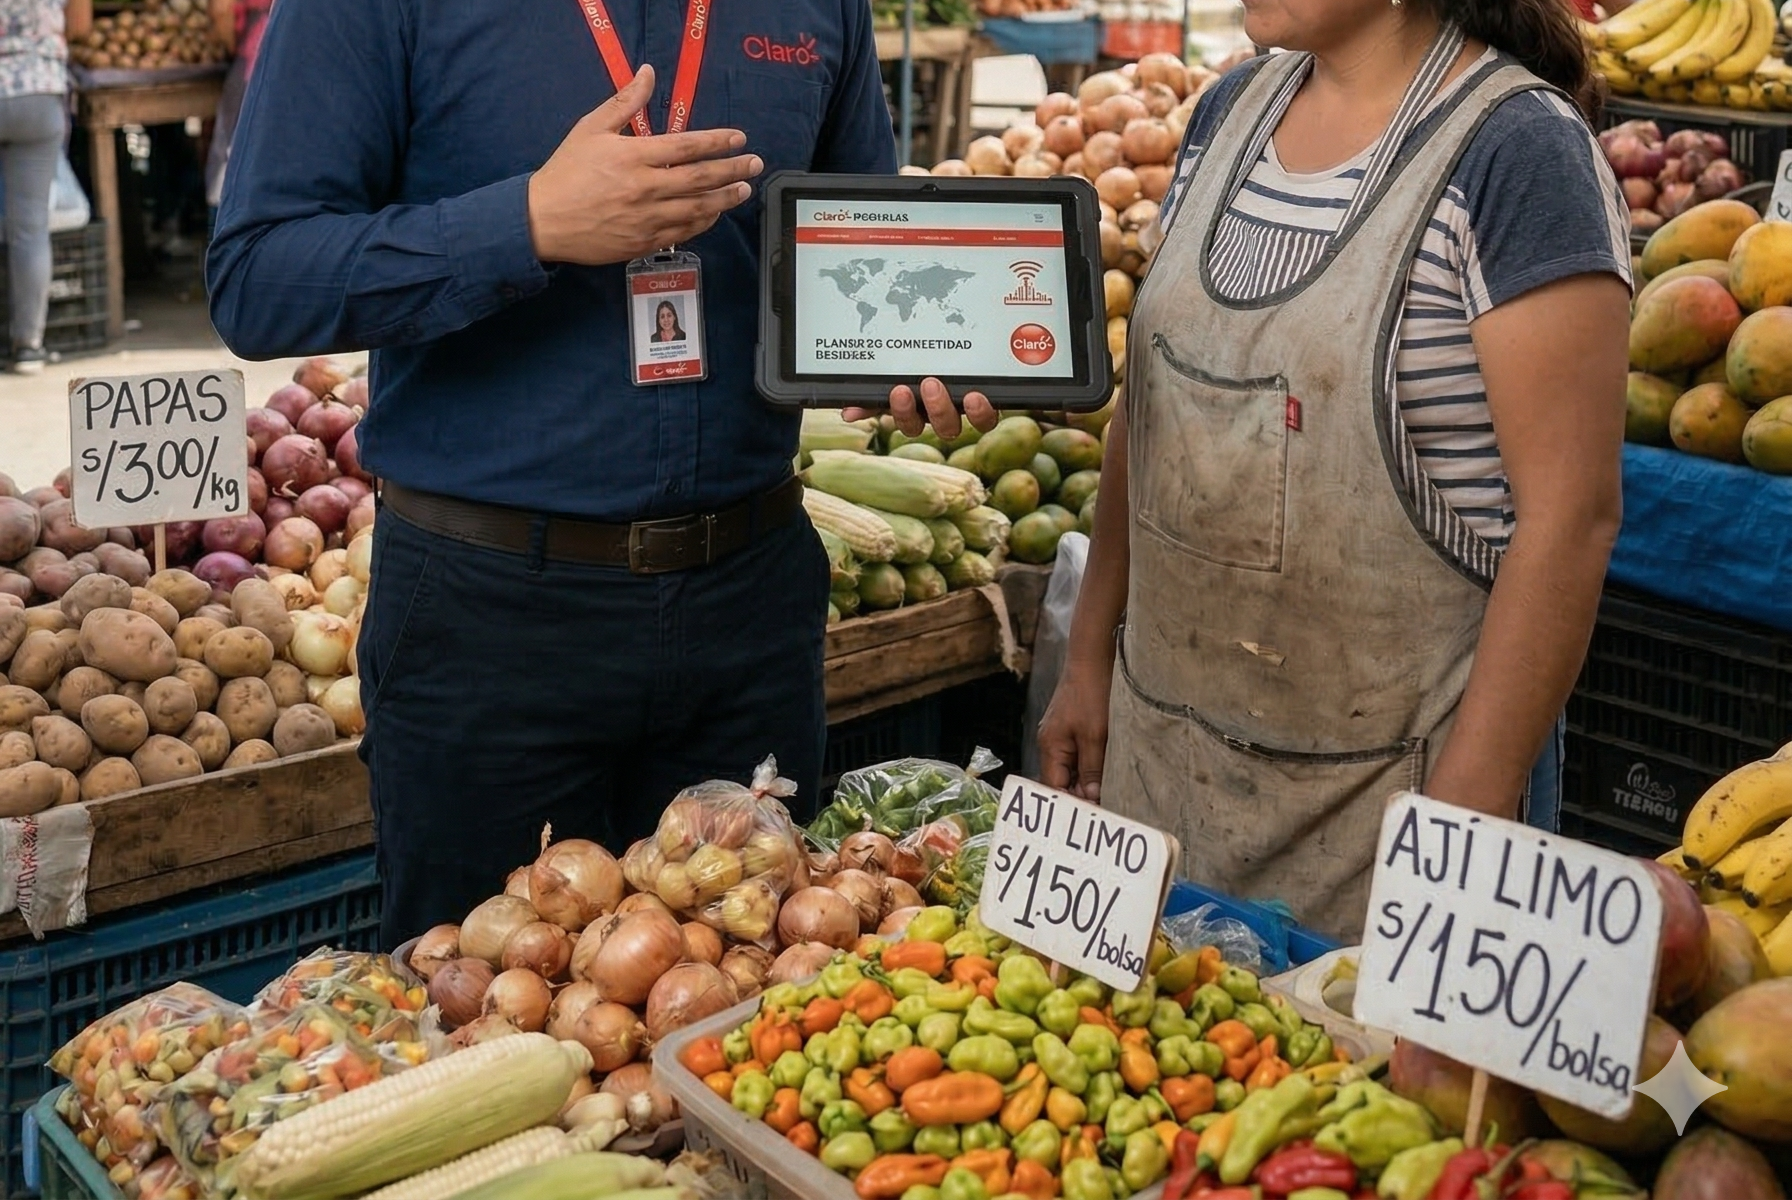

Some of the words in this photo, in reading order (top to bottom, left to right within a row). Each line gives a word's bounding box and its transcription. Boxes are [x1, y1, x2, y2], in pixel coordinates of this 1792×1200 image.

[743, 32, 820, 65] Claro
[1013, 335, 1053, 351] Claro
[76, 374, 228, 431] PAPAS
